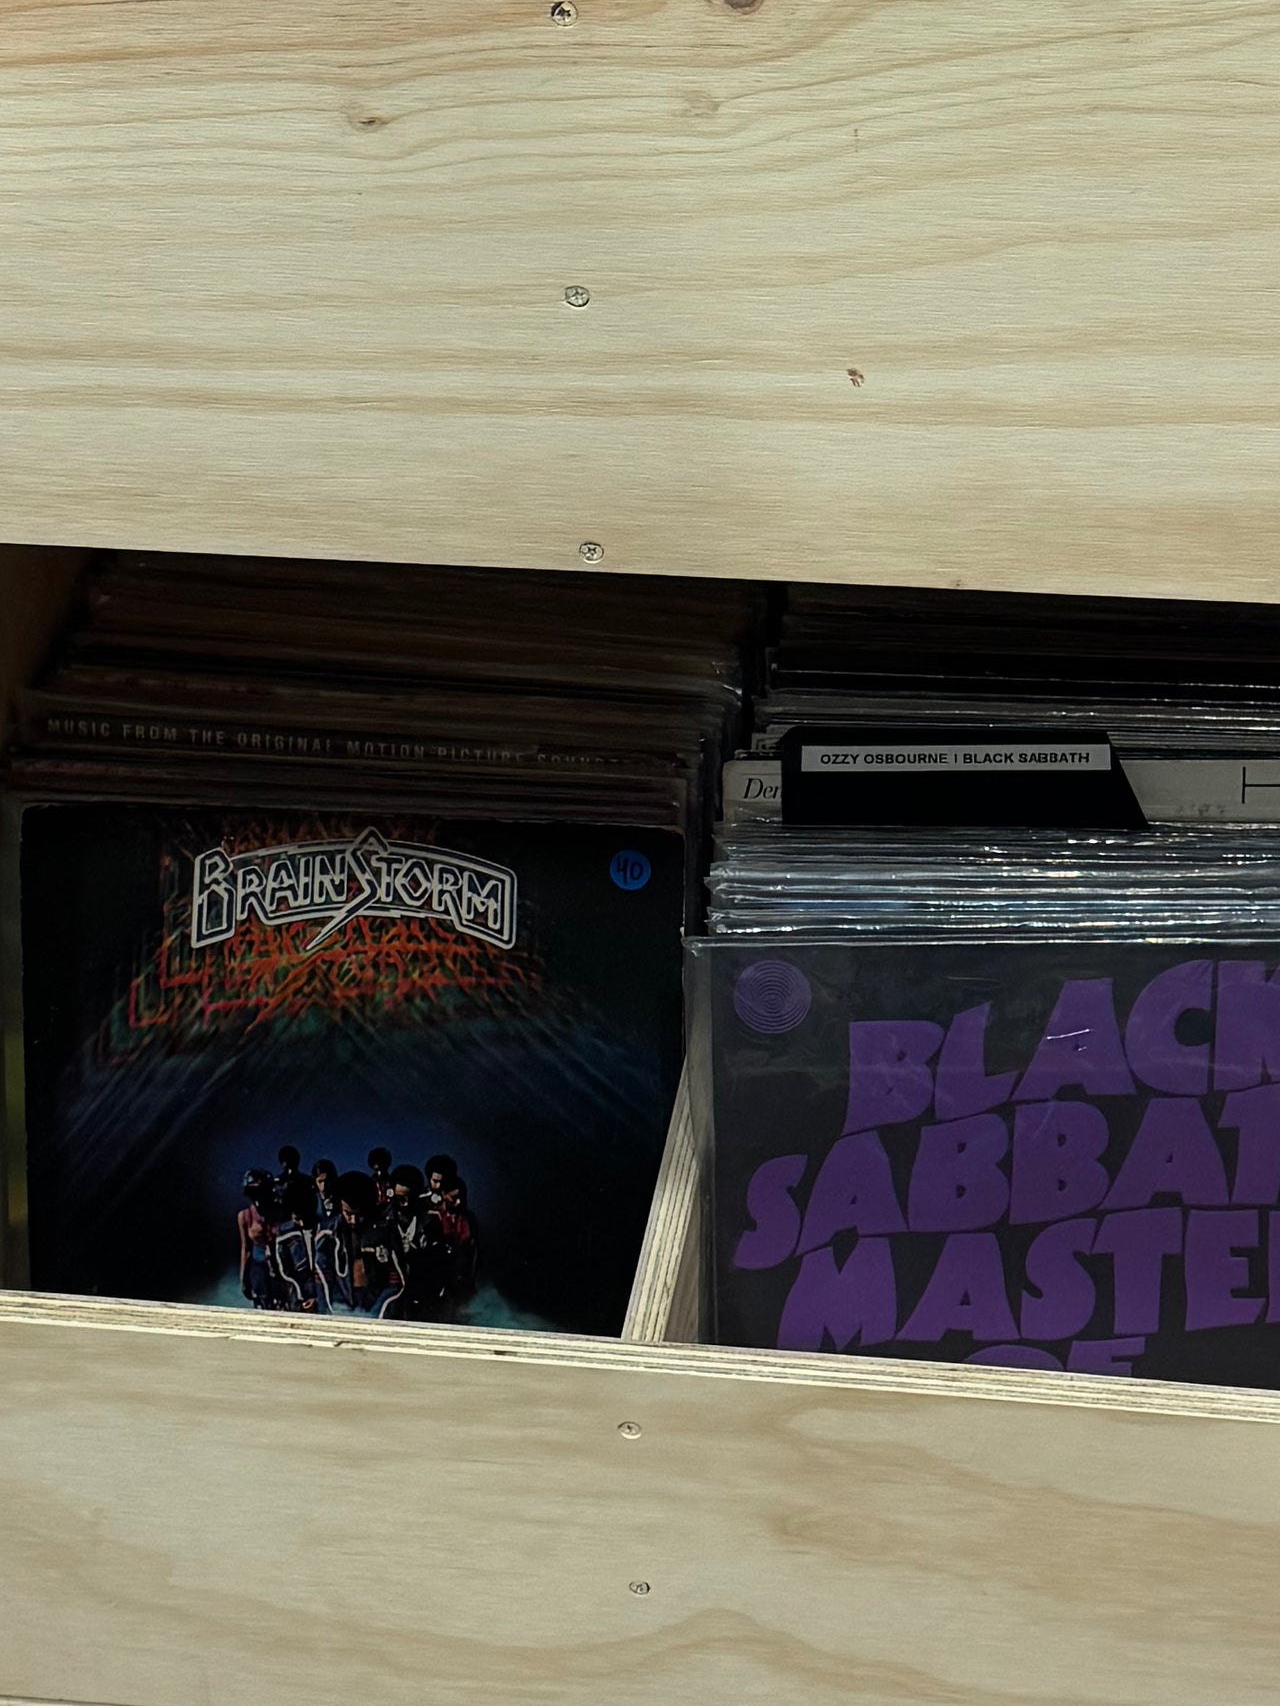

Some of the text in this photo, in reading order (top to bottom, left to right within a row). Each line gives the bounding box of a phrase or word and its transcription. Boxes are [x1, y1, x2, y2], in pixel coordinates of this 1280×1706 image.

[47, 718, 111, 739] MUSIC
[122, 724, 179, 742] FROM
[189, 728, 227, 747] THE
[238, 731, 334, 756] ORIGINAL
[347, 740, 426, 759] MOTION
[820, 752, 860, 765] OZZY
[863, 752, 950, 765] OSBOURNE
[962, 752, 1015, 765] BLACK
[1017, 752, 1091, 765] SABBATH
